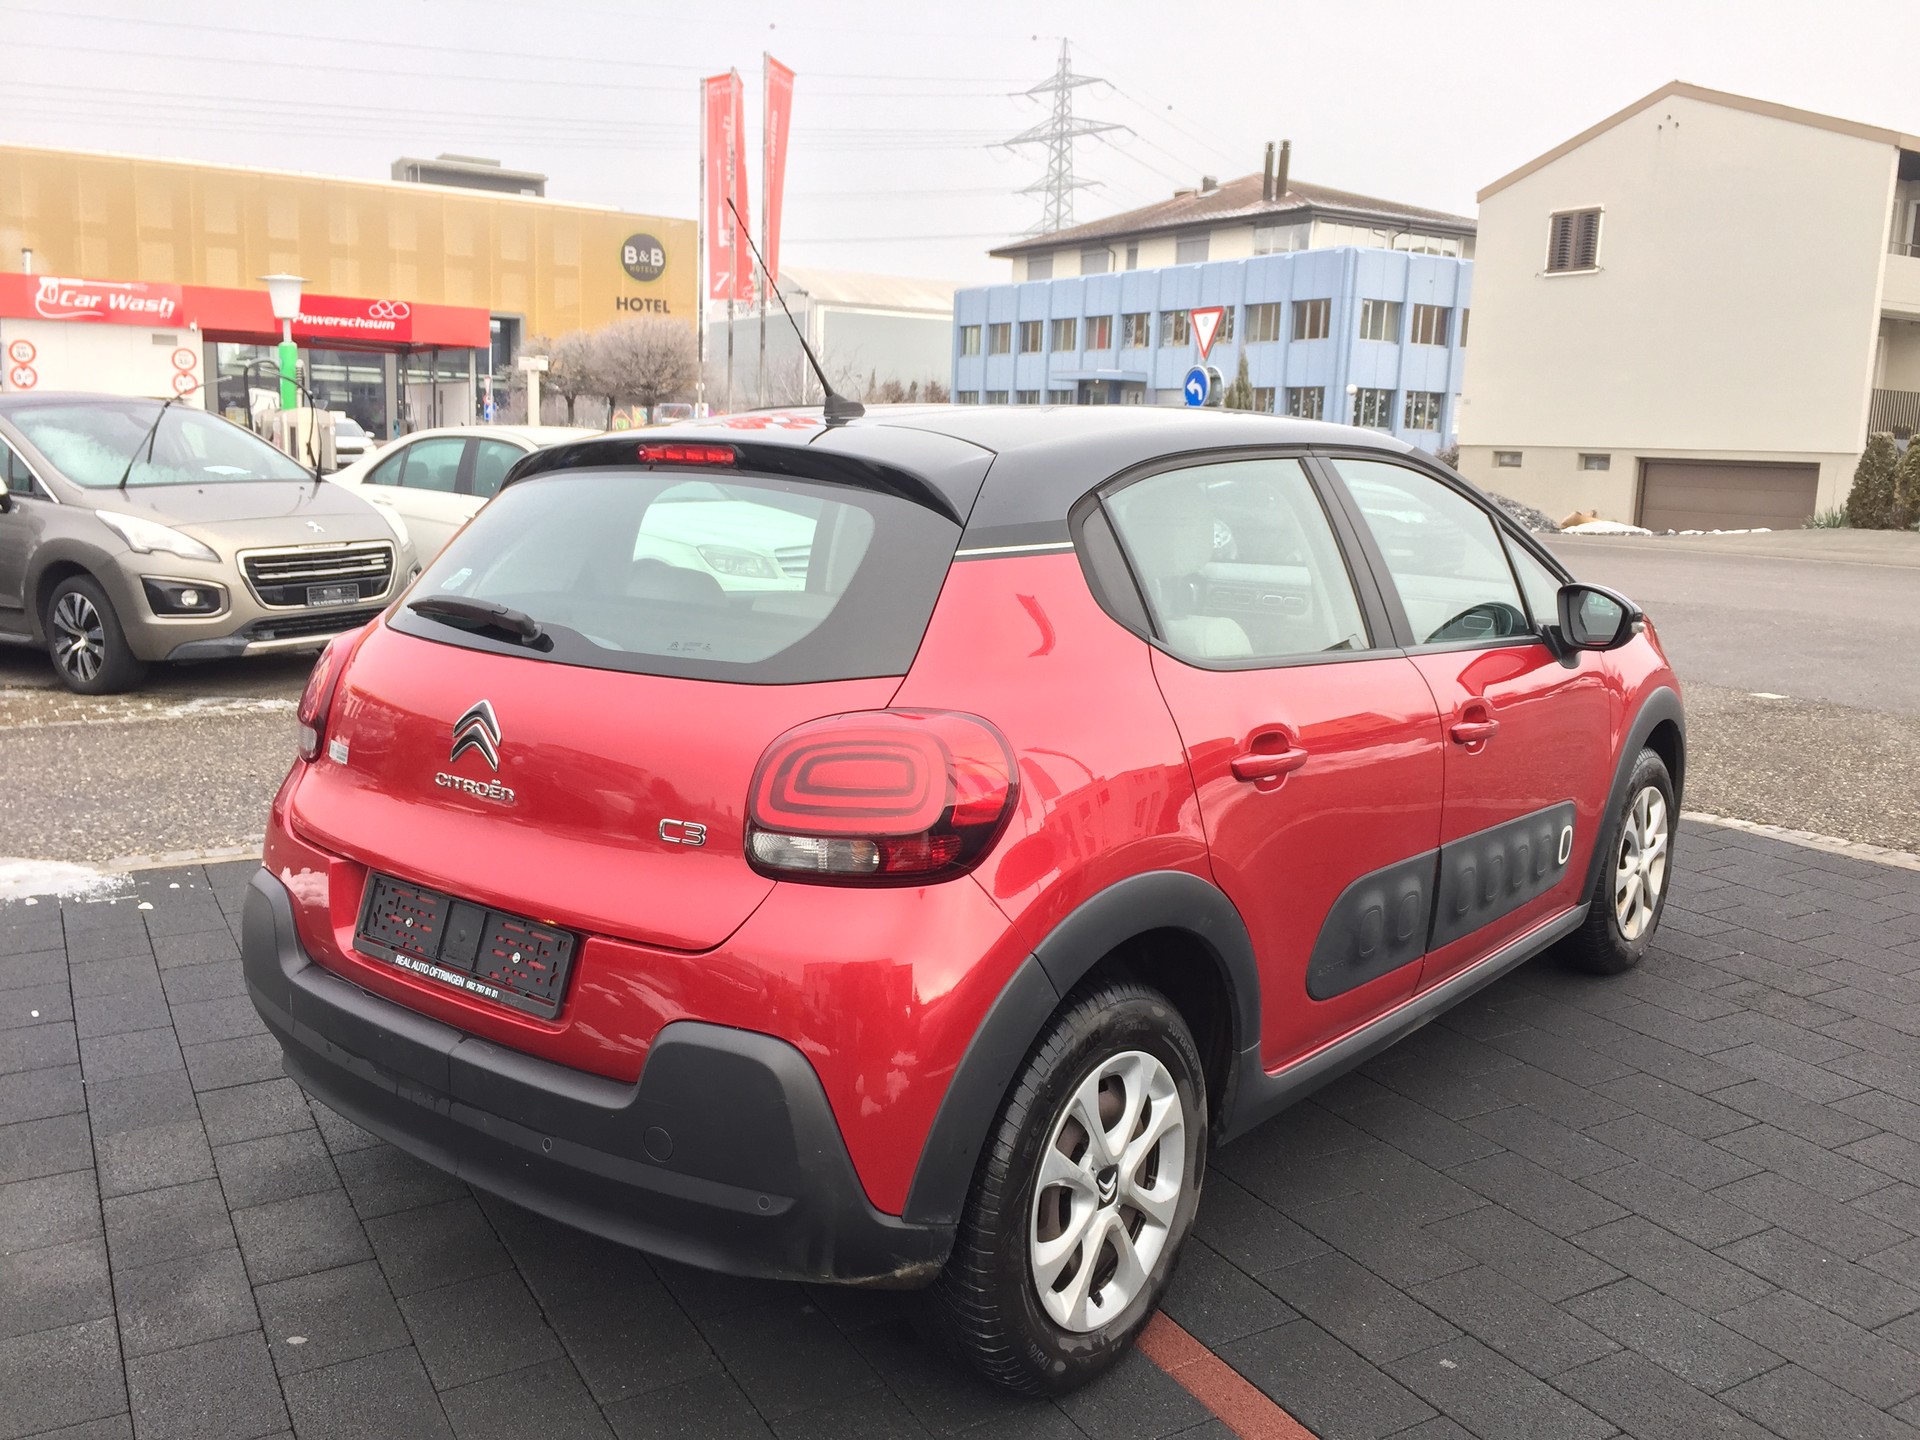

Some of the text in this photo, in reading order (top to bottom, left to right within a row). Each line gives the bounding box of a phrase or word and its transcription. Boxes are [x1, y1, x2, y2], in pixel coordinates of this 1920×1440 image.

[624, 245, 664, 267] B&B
[629, 265, 659, 274] HOTELS
[59, 289, 176, 313] Car Wash
[616, 296, 671, 314] HOTEL
[293, 312, 396, 330] Powerschaum
[659, 818, 707, 846] C3
[395, 954, 412, 969] REAL
[411, 960, 430, 975] AUTO
[429, 967, 466, 987] OFTRINGEN
